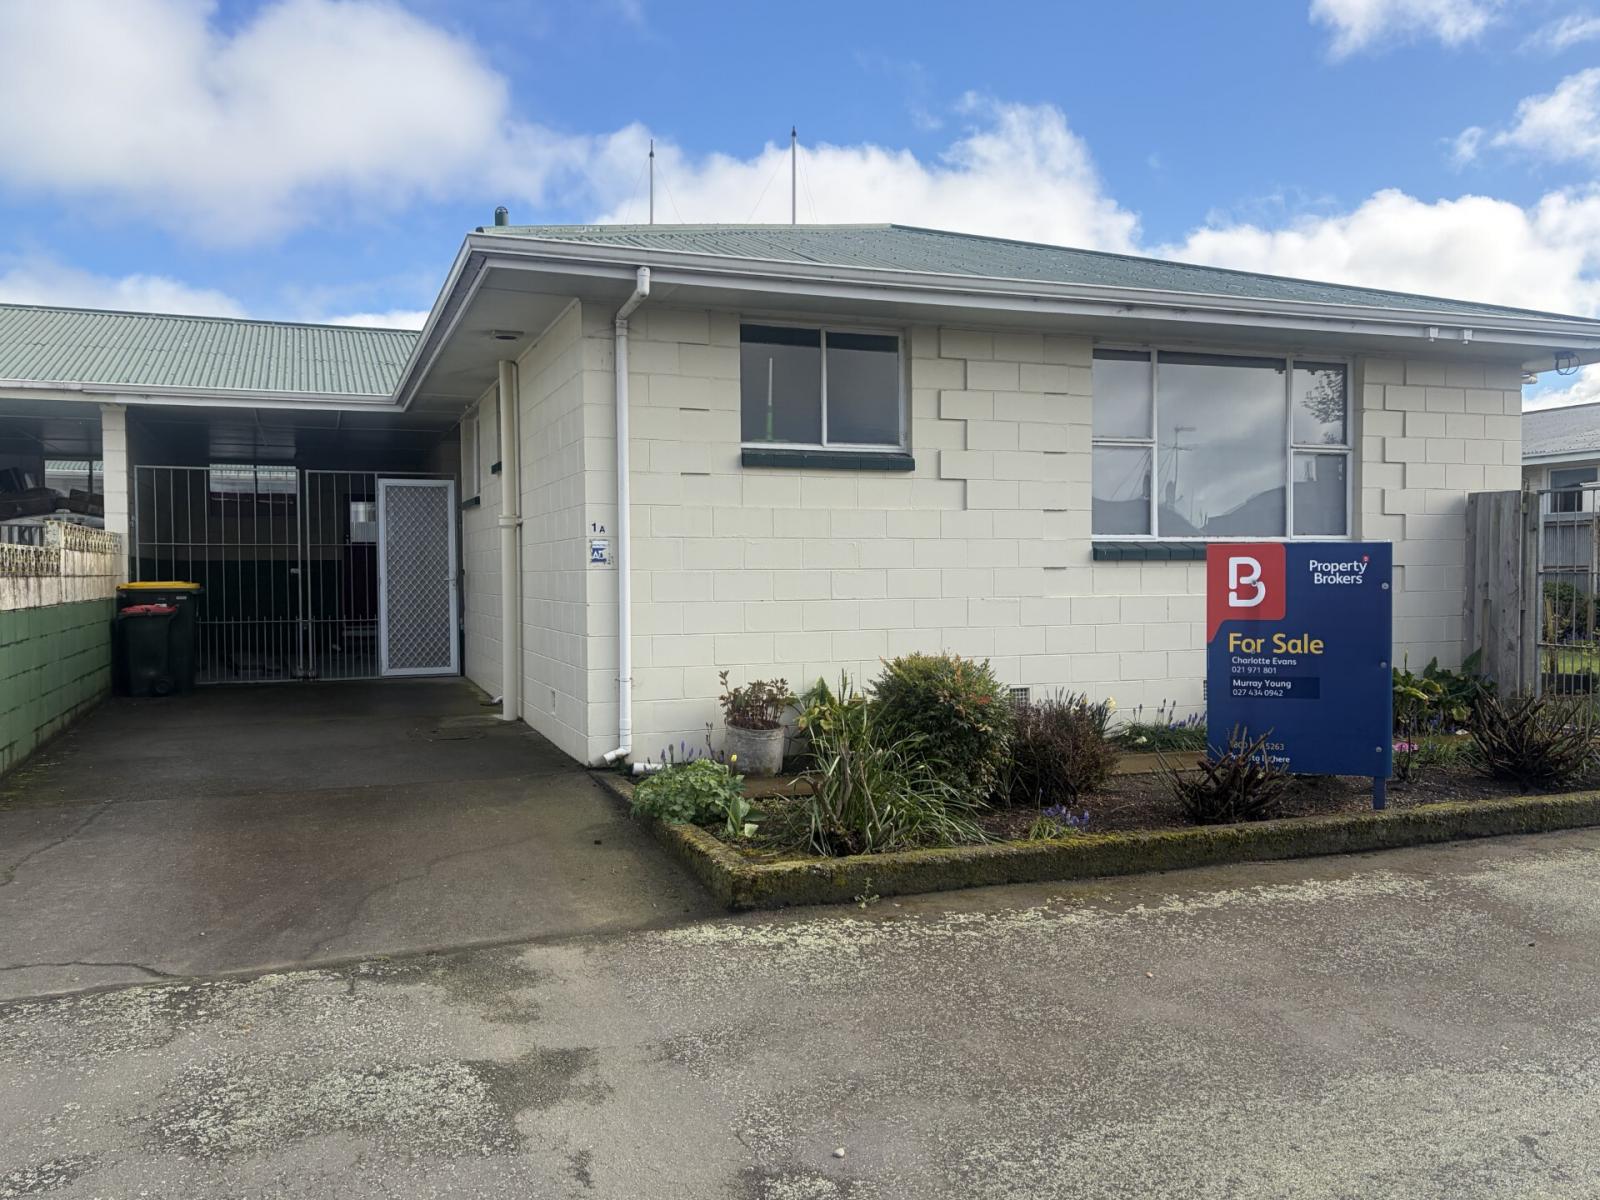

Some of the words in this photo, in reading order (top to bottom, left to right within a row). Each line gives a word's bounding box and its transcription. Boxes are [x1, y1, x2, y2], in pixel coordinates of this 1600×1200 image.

[1309, 559, 1368, 574] Property
[1228, 556, 1266, 607] B
[1314, 572, 1363, 584] Brokers
[1229, 632, 1265, 654] For
[1272, 632, 1324, 654] Sale
[1231, 656, 1270, 665] Charlotte
[1272, 657, 1297, 666] Evans
[1231, 666, 1245, 674] 021
[1247, 666, 1261, 674] 971
[1263, 667, 1277, 675] 801
[1232, 679, 1262, 689] Murray
[1264, 680, 1292, 690] Young
[1232, 688, 1246, 696] 027
[1248, 689, 1263, 697] 434
[1264, 689, 1284, 697] 0942
[1265, 742, 1285, 751] 5263
